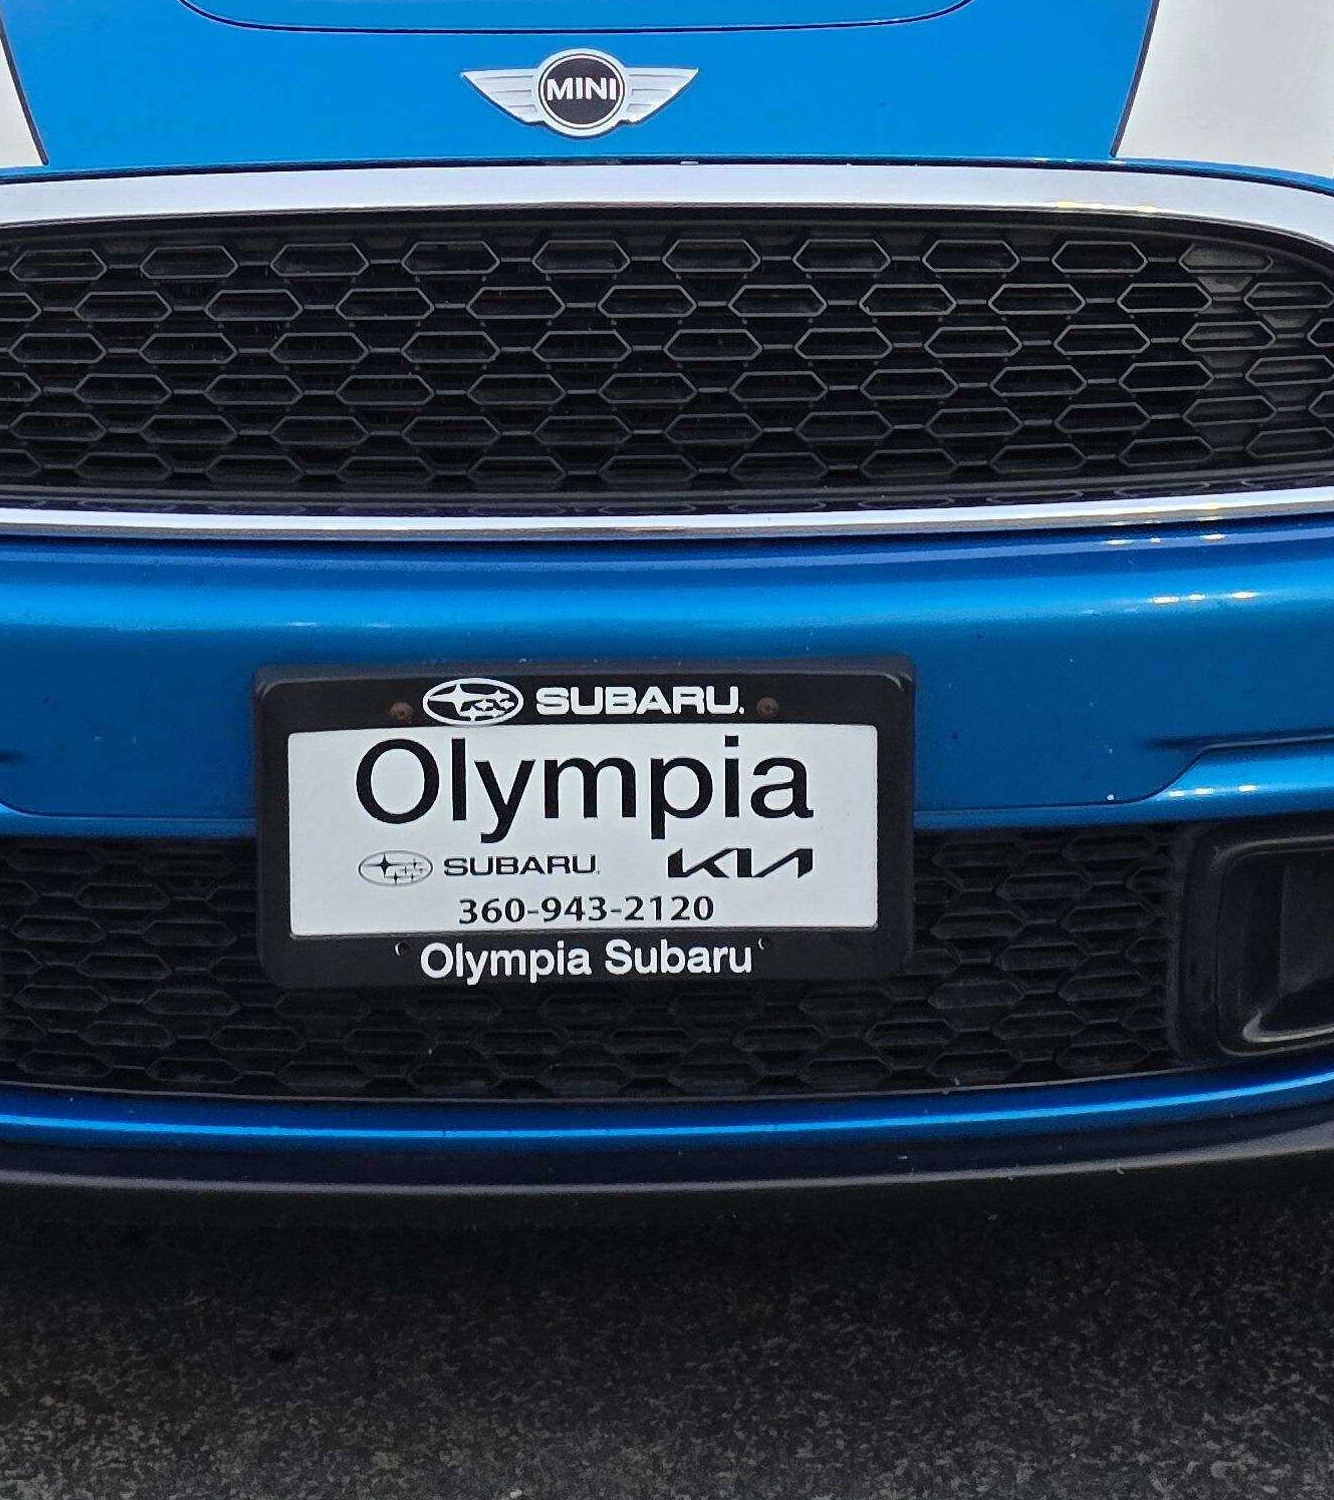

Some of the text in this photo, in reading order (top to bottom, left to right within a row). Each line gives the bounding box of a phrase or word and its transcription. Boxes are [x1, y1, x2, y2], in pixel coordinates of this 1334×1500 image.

[546, 77, 617, 101] MINI
[355, 735, 814, 844] Olympia
[667, 847, 814, 879] KIA
[458, 895, 714, 925] 360-943-2120
[420, 938, 753, 986] Olympia Subaru
